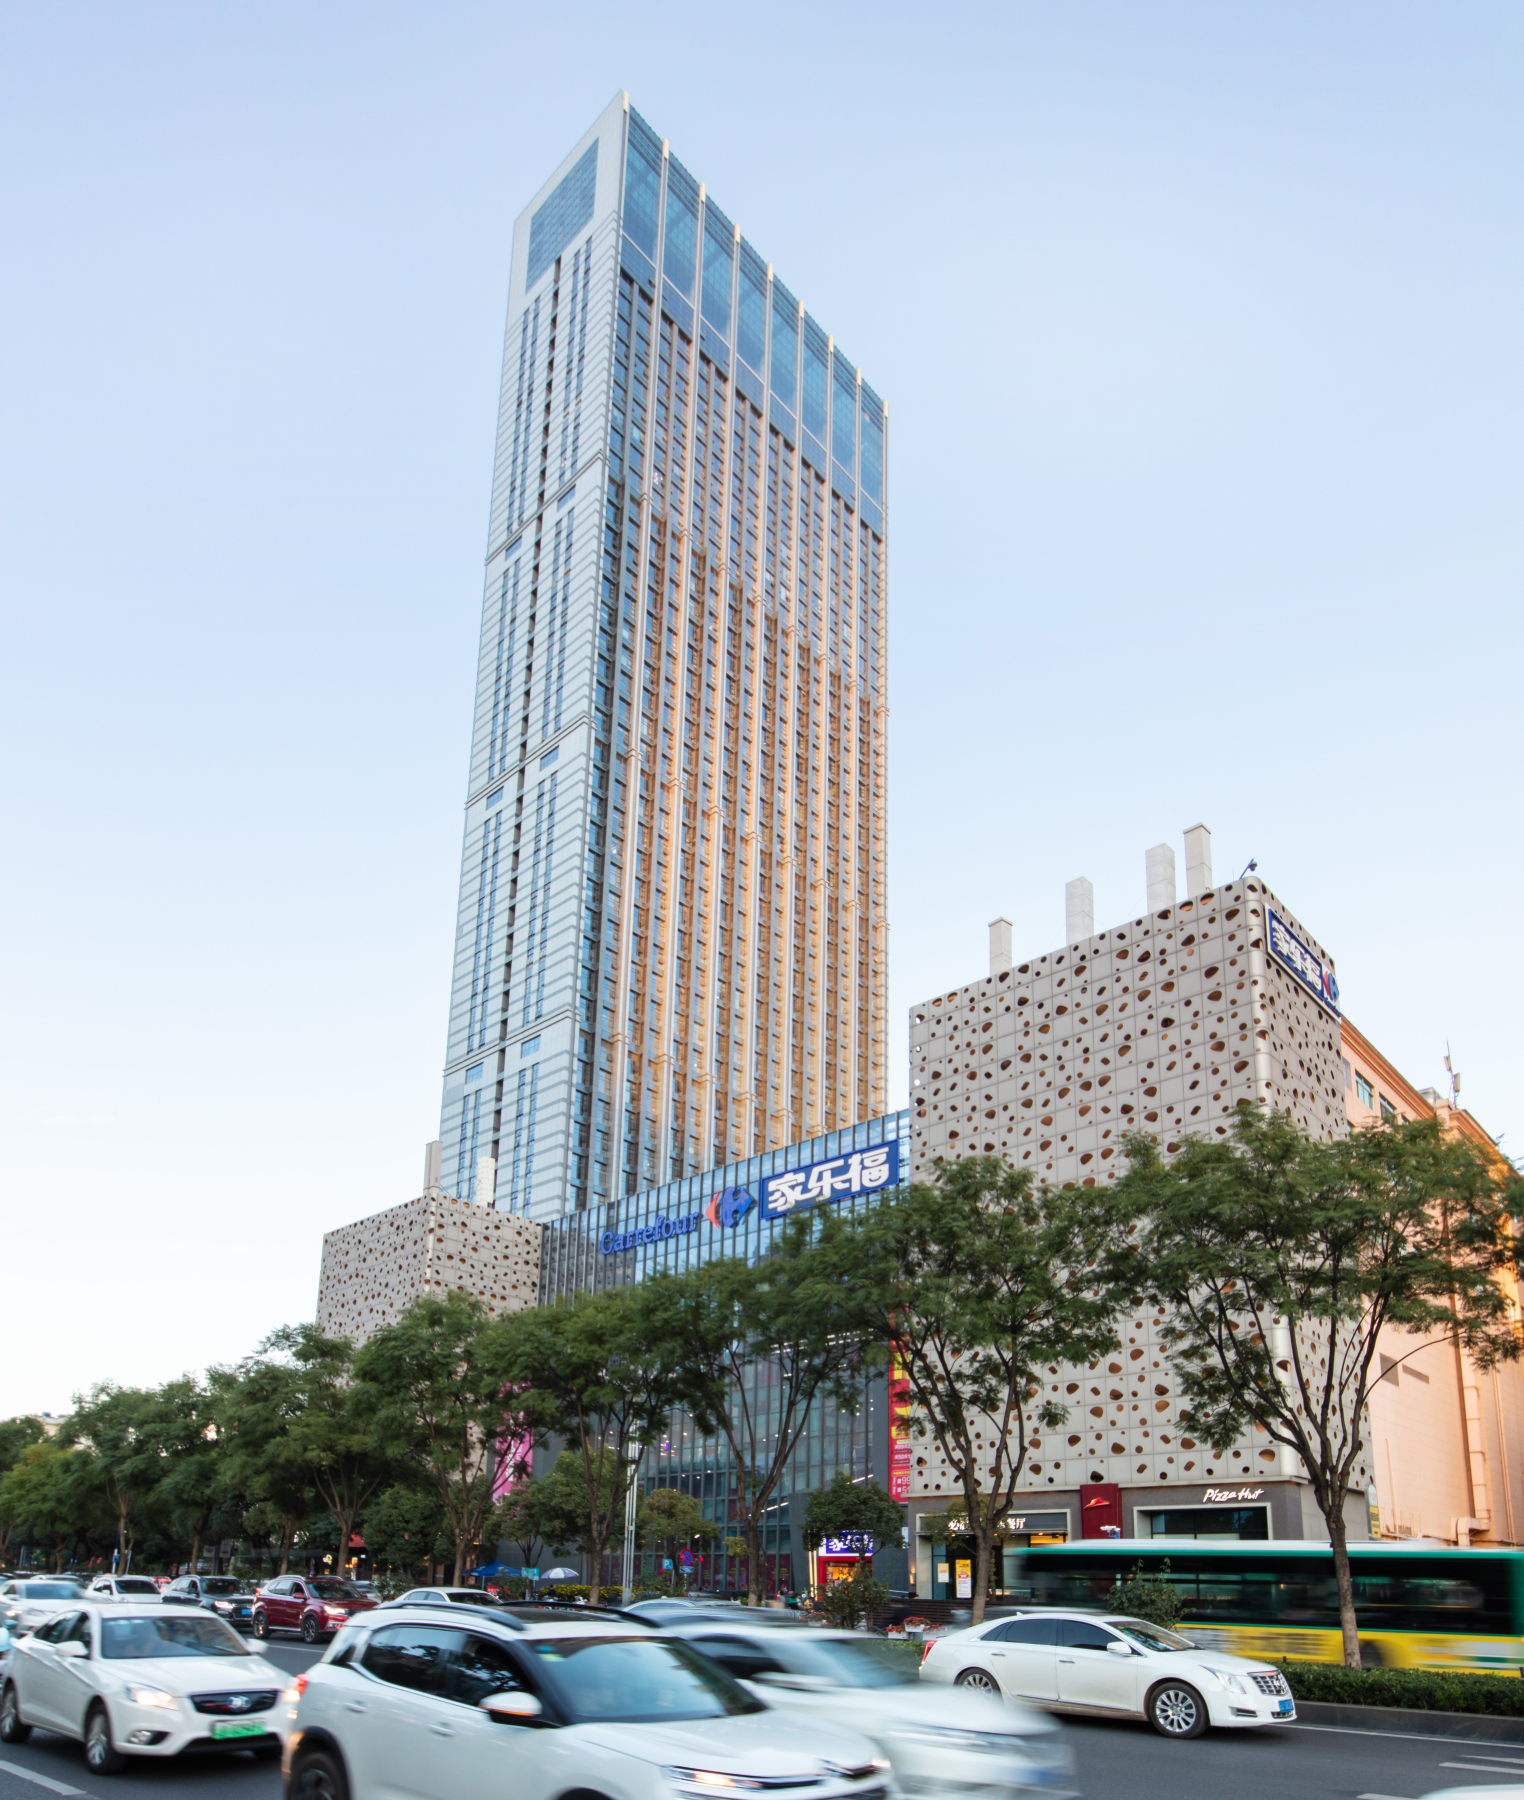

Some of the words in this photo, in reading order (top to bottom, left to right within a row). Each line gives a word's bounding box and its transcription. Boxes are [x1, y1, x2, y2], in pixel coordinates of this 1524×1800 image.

[1271, 919, 1322, 991] 家乐福
[767, 1147, 889, 1212] 家乐福
[600, 1212, 700, 1256] Carrefour
[1202, 1488, 1237, 1503] Pizza
[1237, 1487, 1264, 1501] Hut
